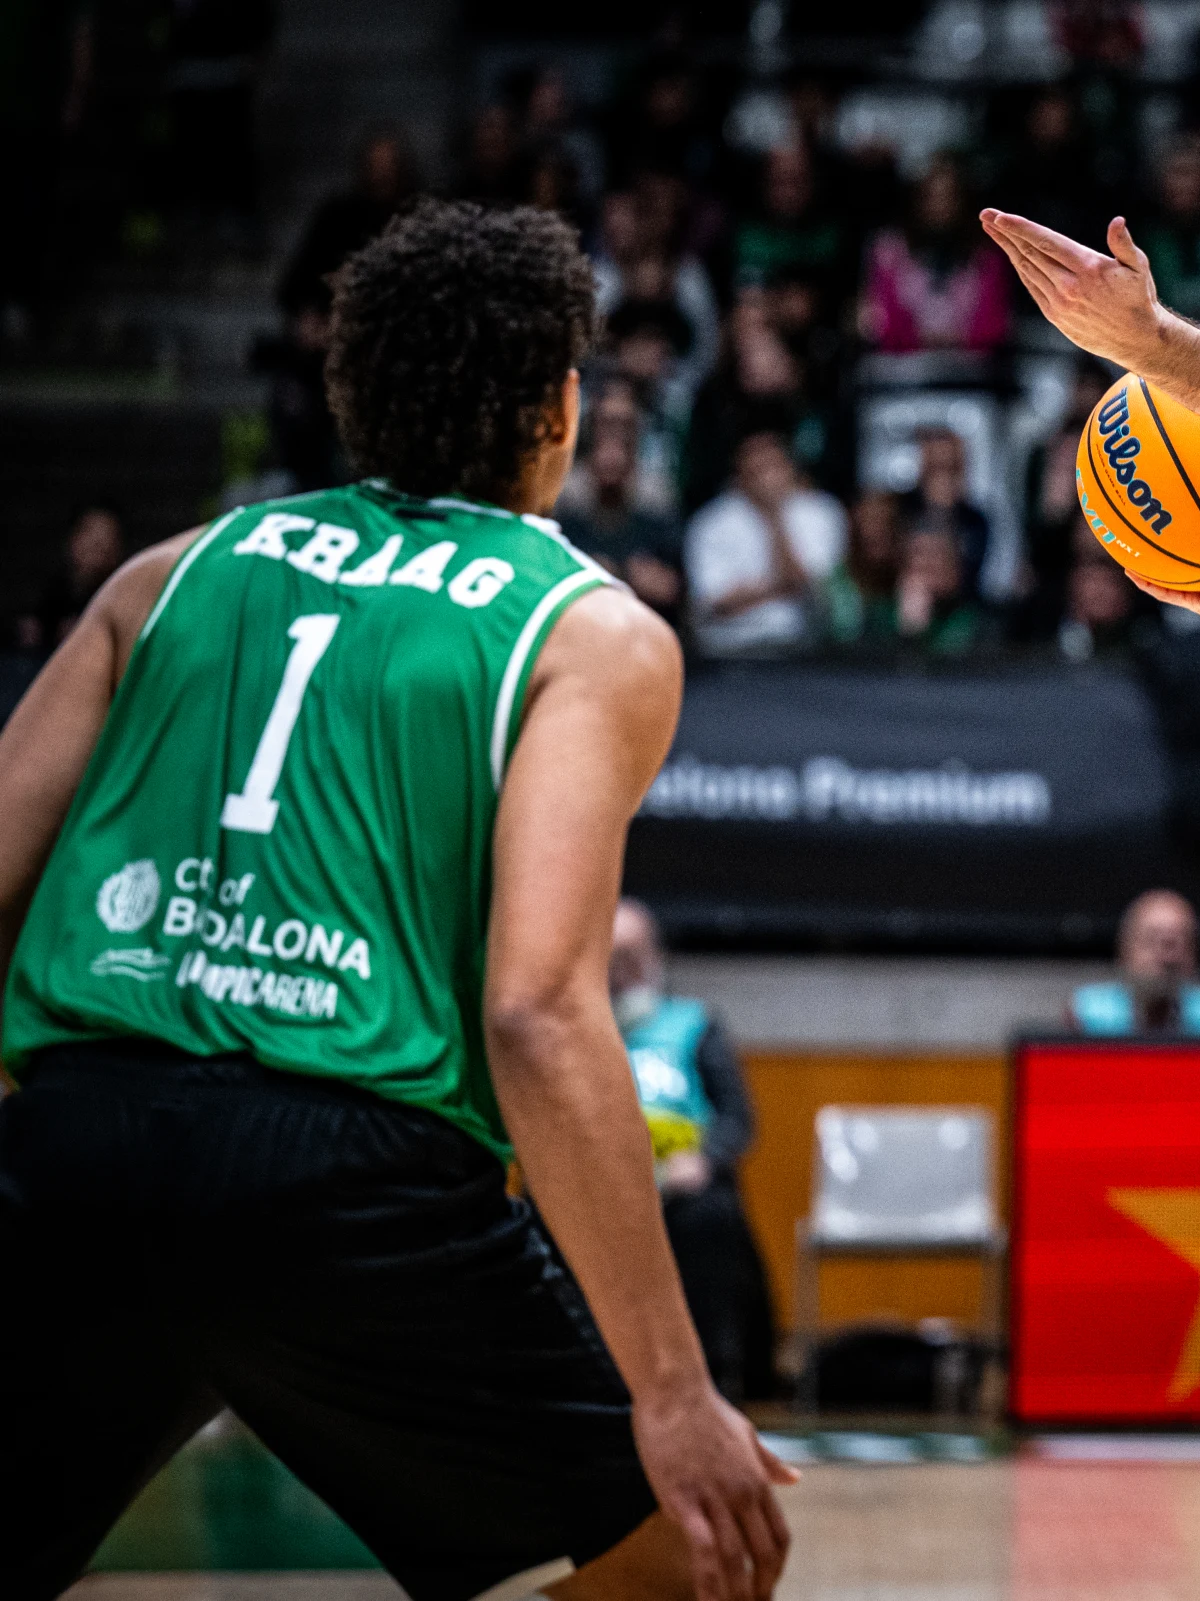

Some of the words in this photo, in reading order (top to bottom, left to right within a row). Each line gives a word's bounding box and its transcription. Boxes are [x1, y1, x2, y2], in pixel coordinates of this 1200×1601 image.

[1097, 386, 1173, 536] Wilson
[220, 613, 341, 834] 1
[163, 895, 372, 981] BDALONA
[219, 872, 257, 908] of
